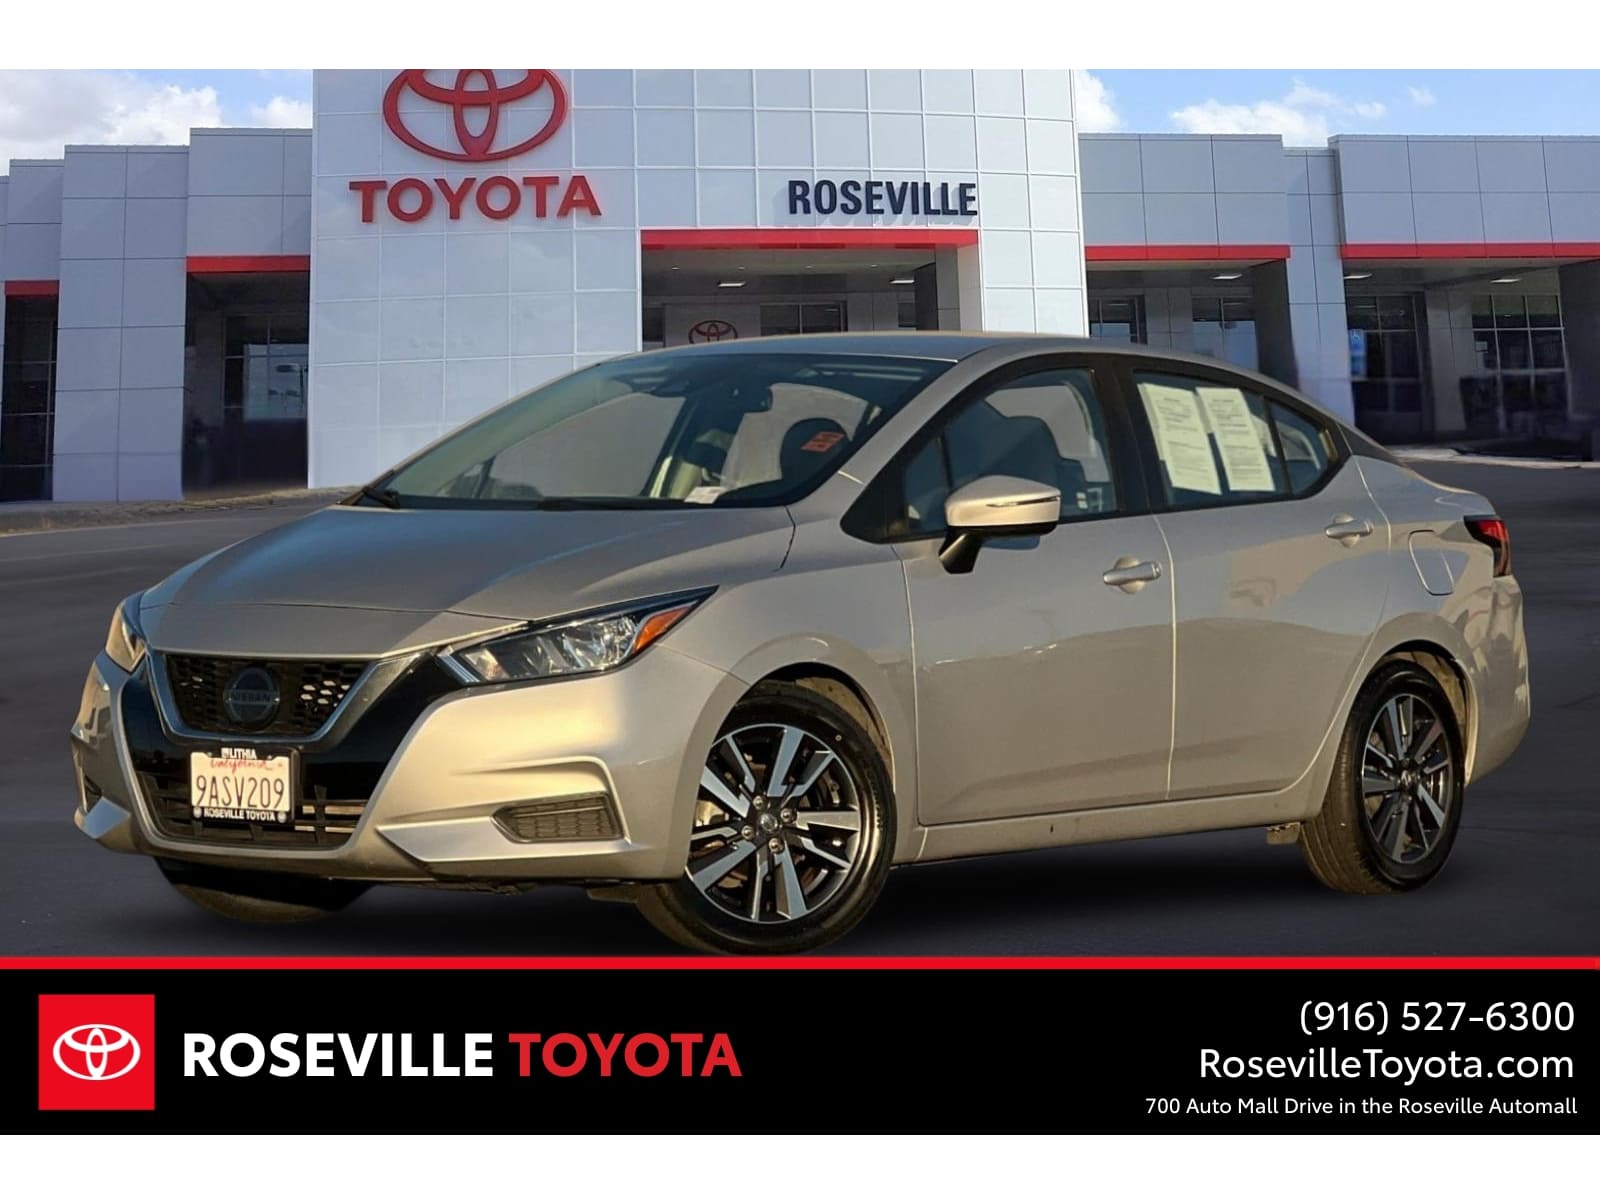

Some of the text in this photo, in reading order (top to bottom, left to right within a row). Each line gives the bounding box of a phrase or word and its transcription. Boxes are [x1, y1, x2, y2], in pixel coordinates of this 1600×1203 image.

[349, 175, 602, 223] TOYOTA
[788, 179, 979, 217] ROSEVILLE
[195, 775, 285, 809] 9ASV209
[203, 808, 277, 822] ROSEVILLE TOYOTA
